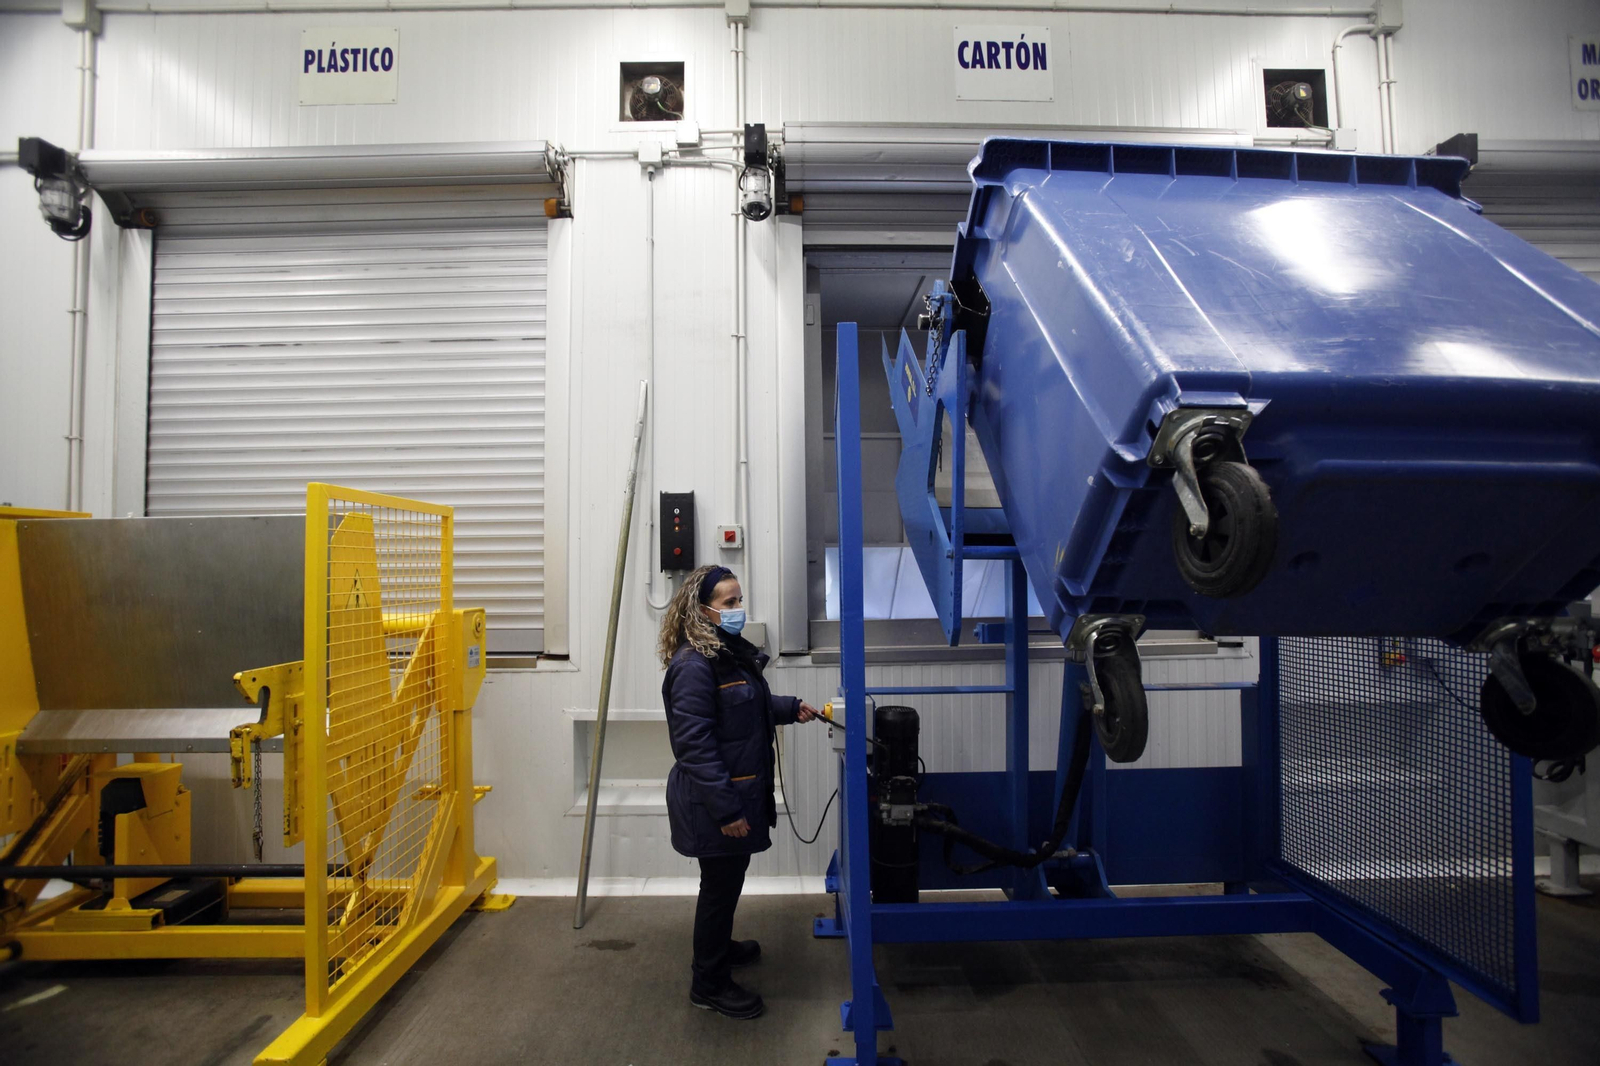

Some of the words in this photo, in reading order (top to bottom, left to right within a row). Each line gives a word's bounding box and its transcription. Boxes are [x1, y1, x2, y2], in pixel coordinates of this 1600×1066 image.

[304, 42, 394, 73] PLÁSTICO
[957, 33, 1047, 70] CARTÓN
[1582, 43, 1600, 65] M
